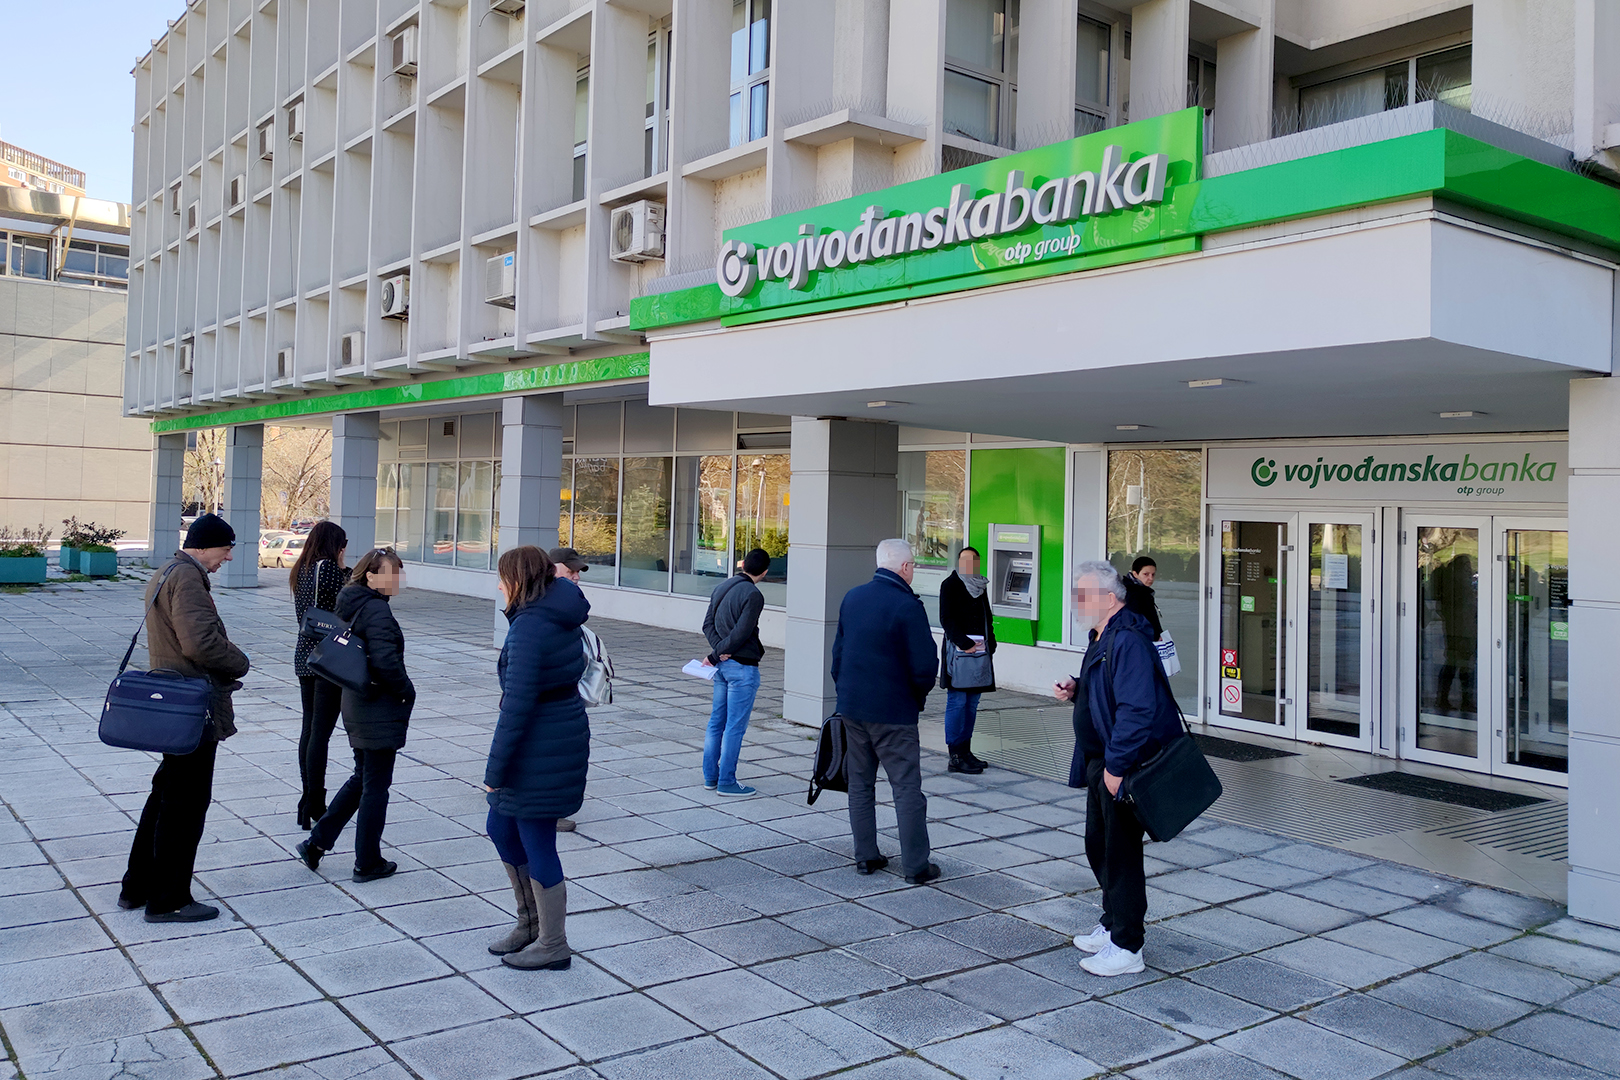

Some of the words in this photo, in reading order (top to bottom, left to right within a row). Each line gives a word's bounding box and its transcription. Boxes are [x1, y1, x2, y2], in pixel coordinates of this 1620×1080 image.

[756, 144, 1169, 290] vojvođanskabanka
[1005, 241, 1032, 264] otp
[1034, 234, 1081, 261] group
[1285, 453, 1557, 489] vojvođanskabanka
[1456, 485, 1474, 496] otp
[1475, 486, 1505, 497] group
